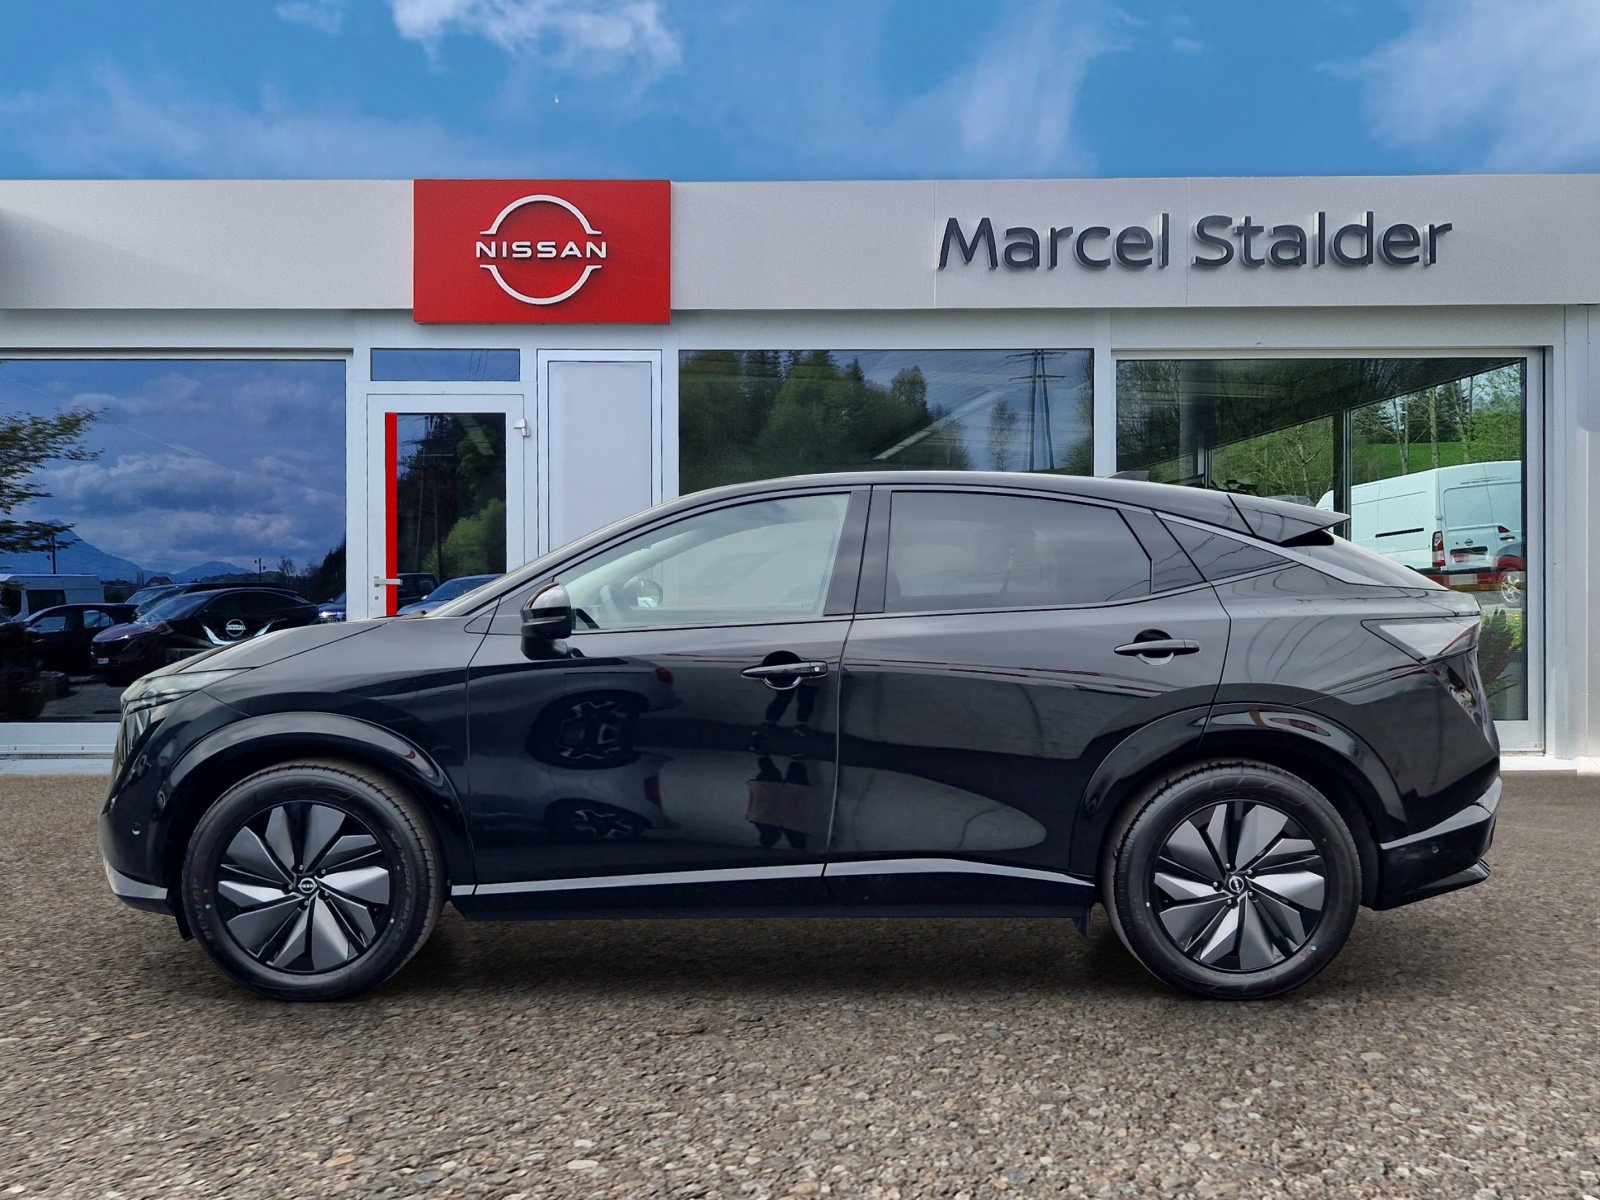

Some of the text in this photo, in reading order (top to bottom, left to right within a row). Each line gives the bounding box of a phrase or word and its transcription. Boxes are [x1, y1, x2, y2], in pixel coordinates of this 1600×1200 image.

[476, 241, 607, 259] NISSAN
[938, 210, 1453, 270] Marcel Stalder
